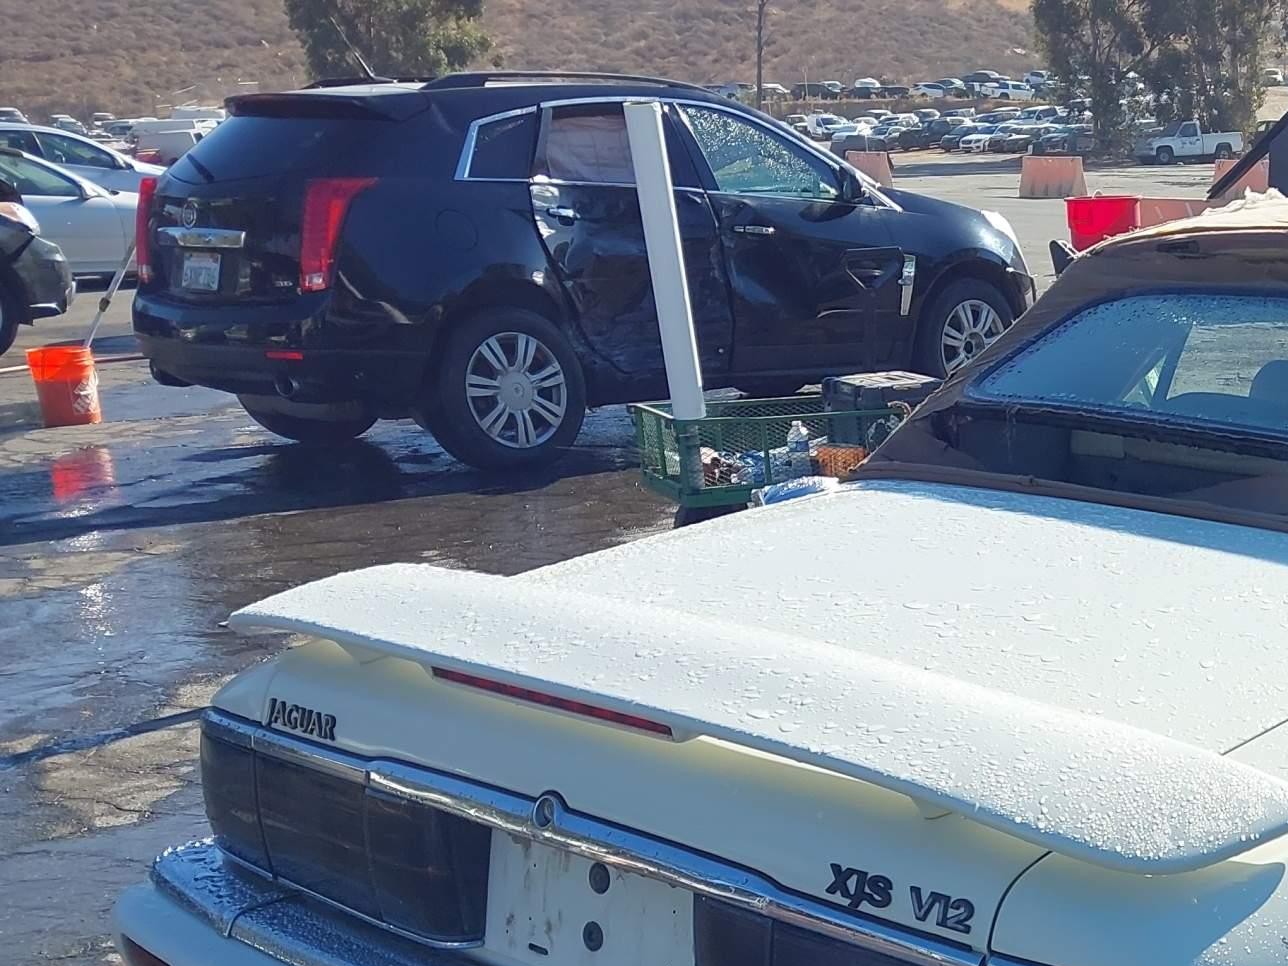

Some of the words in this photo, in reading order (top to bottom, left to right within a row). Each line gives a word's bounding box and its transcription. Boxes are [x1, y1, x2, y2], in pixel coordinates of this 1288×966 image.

[262, 697, 337, 741] JAGUAR
[825, 863, 894, 909] XJS
[910, 885, 975, 935] V12
